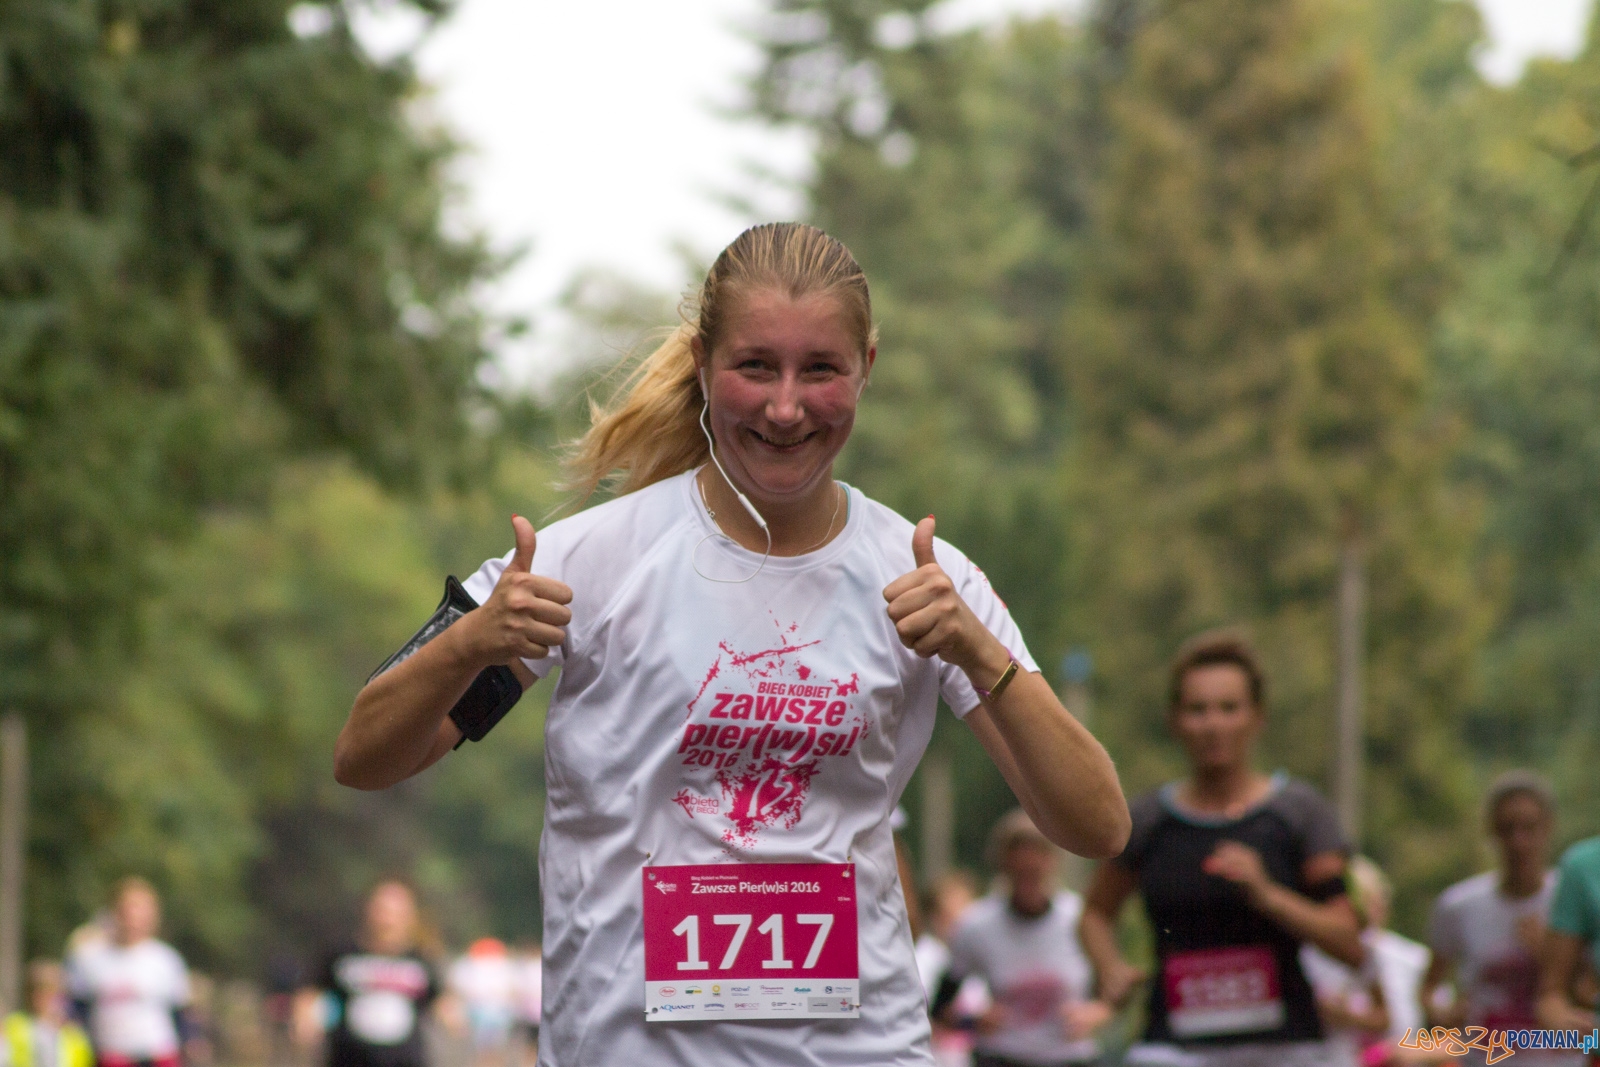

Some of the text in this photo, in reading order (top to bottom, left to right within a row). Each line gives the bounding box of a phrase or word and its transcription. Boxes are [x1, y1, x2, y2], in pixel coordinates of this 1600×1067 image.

[757, 682, 832, 698] BIEG KOBIET
[709, 693, 847, 726] zawsze
[682, 749, 740, 769] 2016
[691, 882, 736, 894] Zawsze
[739, 881, 788, 895] Pier(w)si
[790, 881, 820, 893] 2016
[672, 913, 834, 970] 1717
